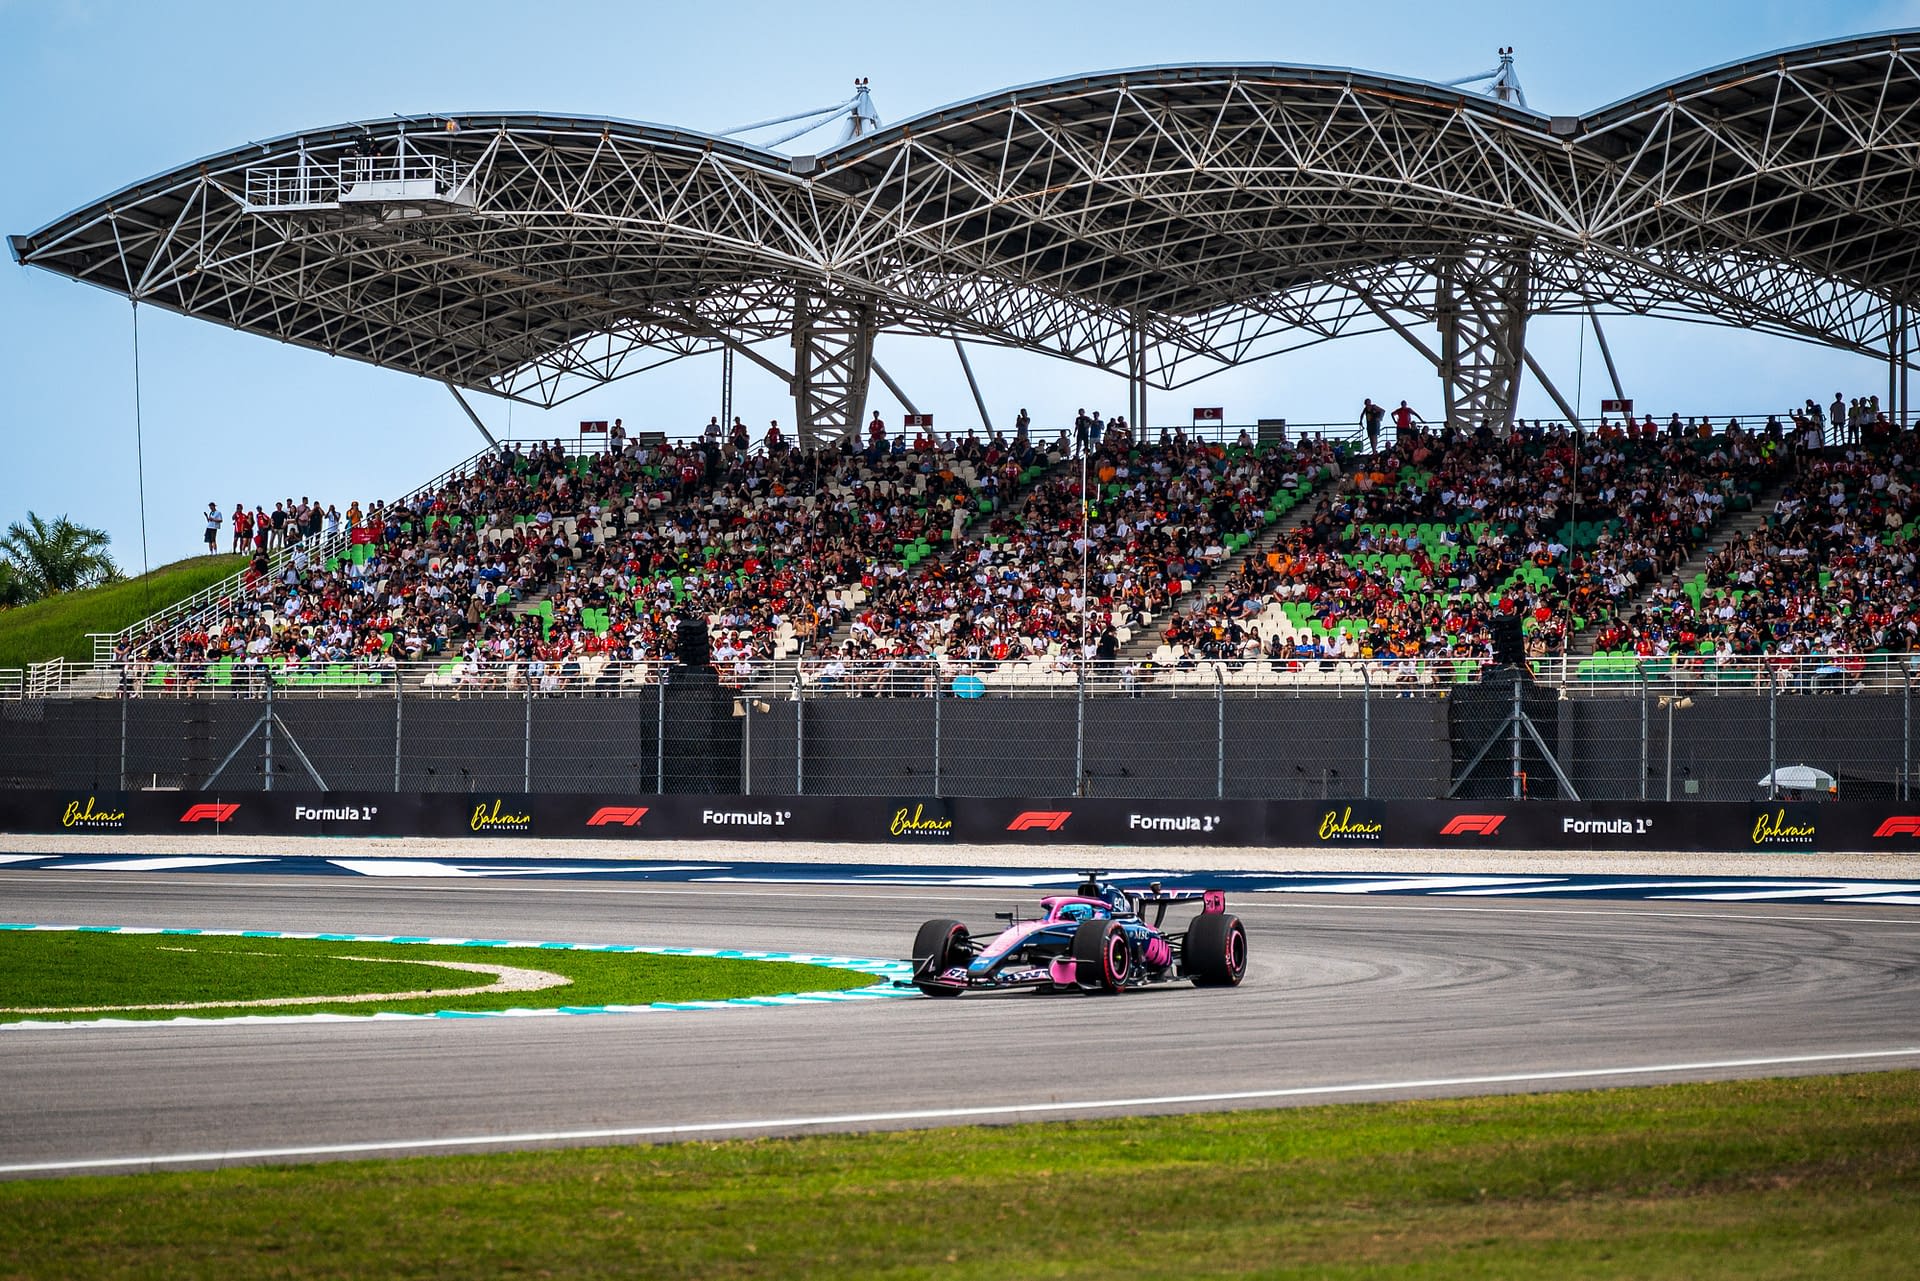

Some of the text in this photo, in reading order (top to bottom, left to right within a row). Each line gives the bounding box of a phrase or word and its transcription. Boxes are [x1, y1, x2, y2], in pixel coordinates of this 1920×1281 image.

[1612, 401, 1622, 411] D
[914, 416, 923, 425] B
[1203, 409, 1213, 419] C
[590, 422, 598, 432] A
[63, 797, 124, 827] Bahrain
[295, 807, 359, 821] Formula
[471, 800, 530, 831] Bahrain
[703, 811, 771, 825] Formula
[891, 804, 952, 835] Bahrain
[1130, 815, 1201, 830] Formula
[1319, 807, 1382, 839] Bahrain
[1563, 818, 1633, 834] Formula
[1753, 809, 1815, 843] Bahrain
[1134, 930, 1150, 940] MSC
